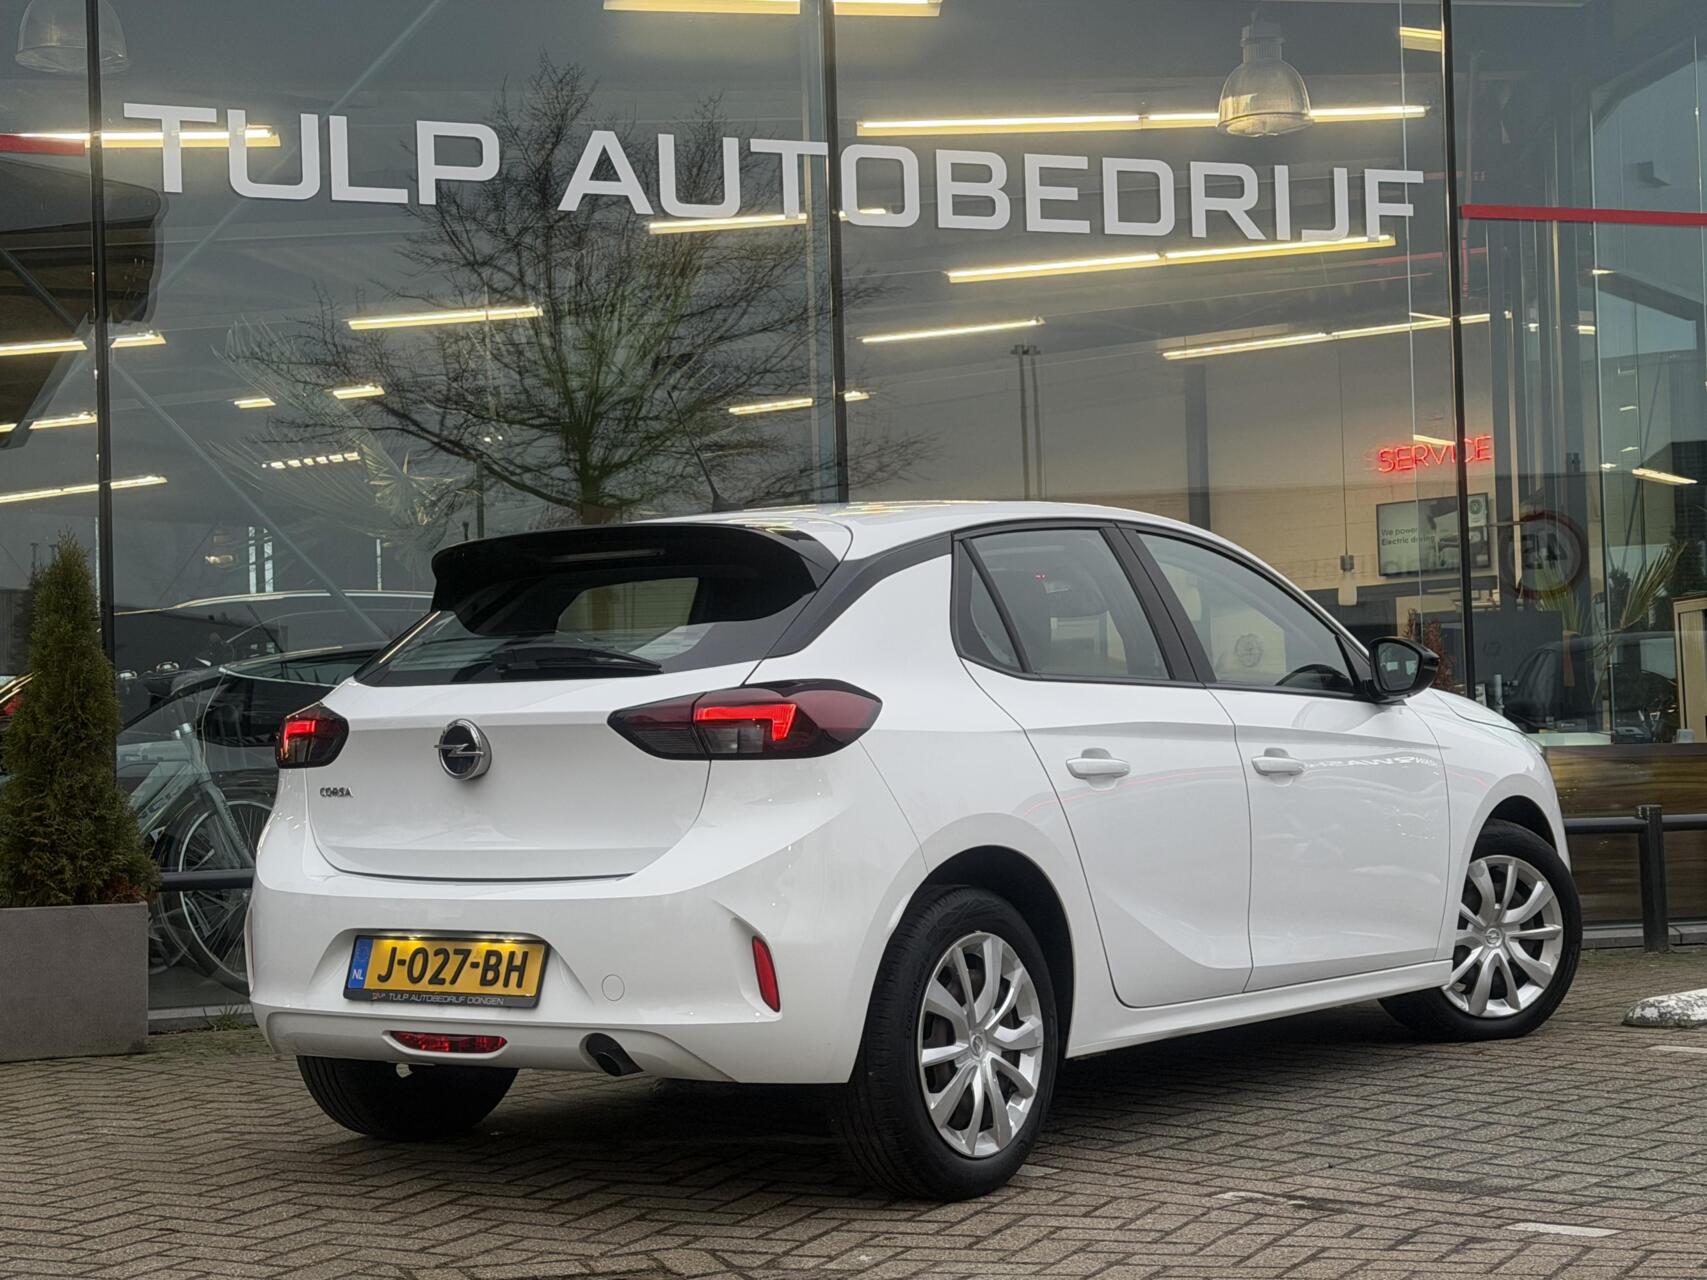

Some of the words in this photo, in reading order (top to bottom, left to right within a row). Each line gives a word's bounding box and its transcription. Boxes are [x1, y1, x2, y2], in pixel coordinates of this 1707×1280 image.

[123, 102, 501, 206] TULP
[558, 130, 1425, 242] AUTOBEDRIJF
[1377, 434, 1493, 473] SERVICE
[1381, 536, 1409, 546] Electric
[319, 786, 353, 798] CORSA
[376, 946, 530, 989] J-027-BH
[351, 968, 364, 981] NL
[389, 992, 409, 1001] TULP
[410, 994, 465, 1003] AUTOBEDRIJF
[466, 996, 504, 1005] DONGEN
